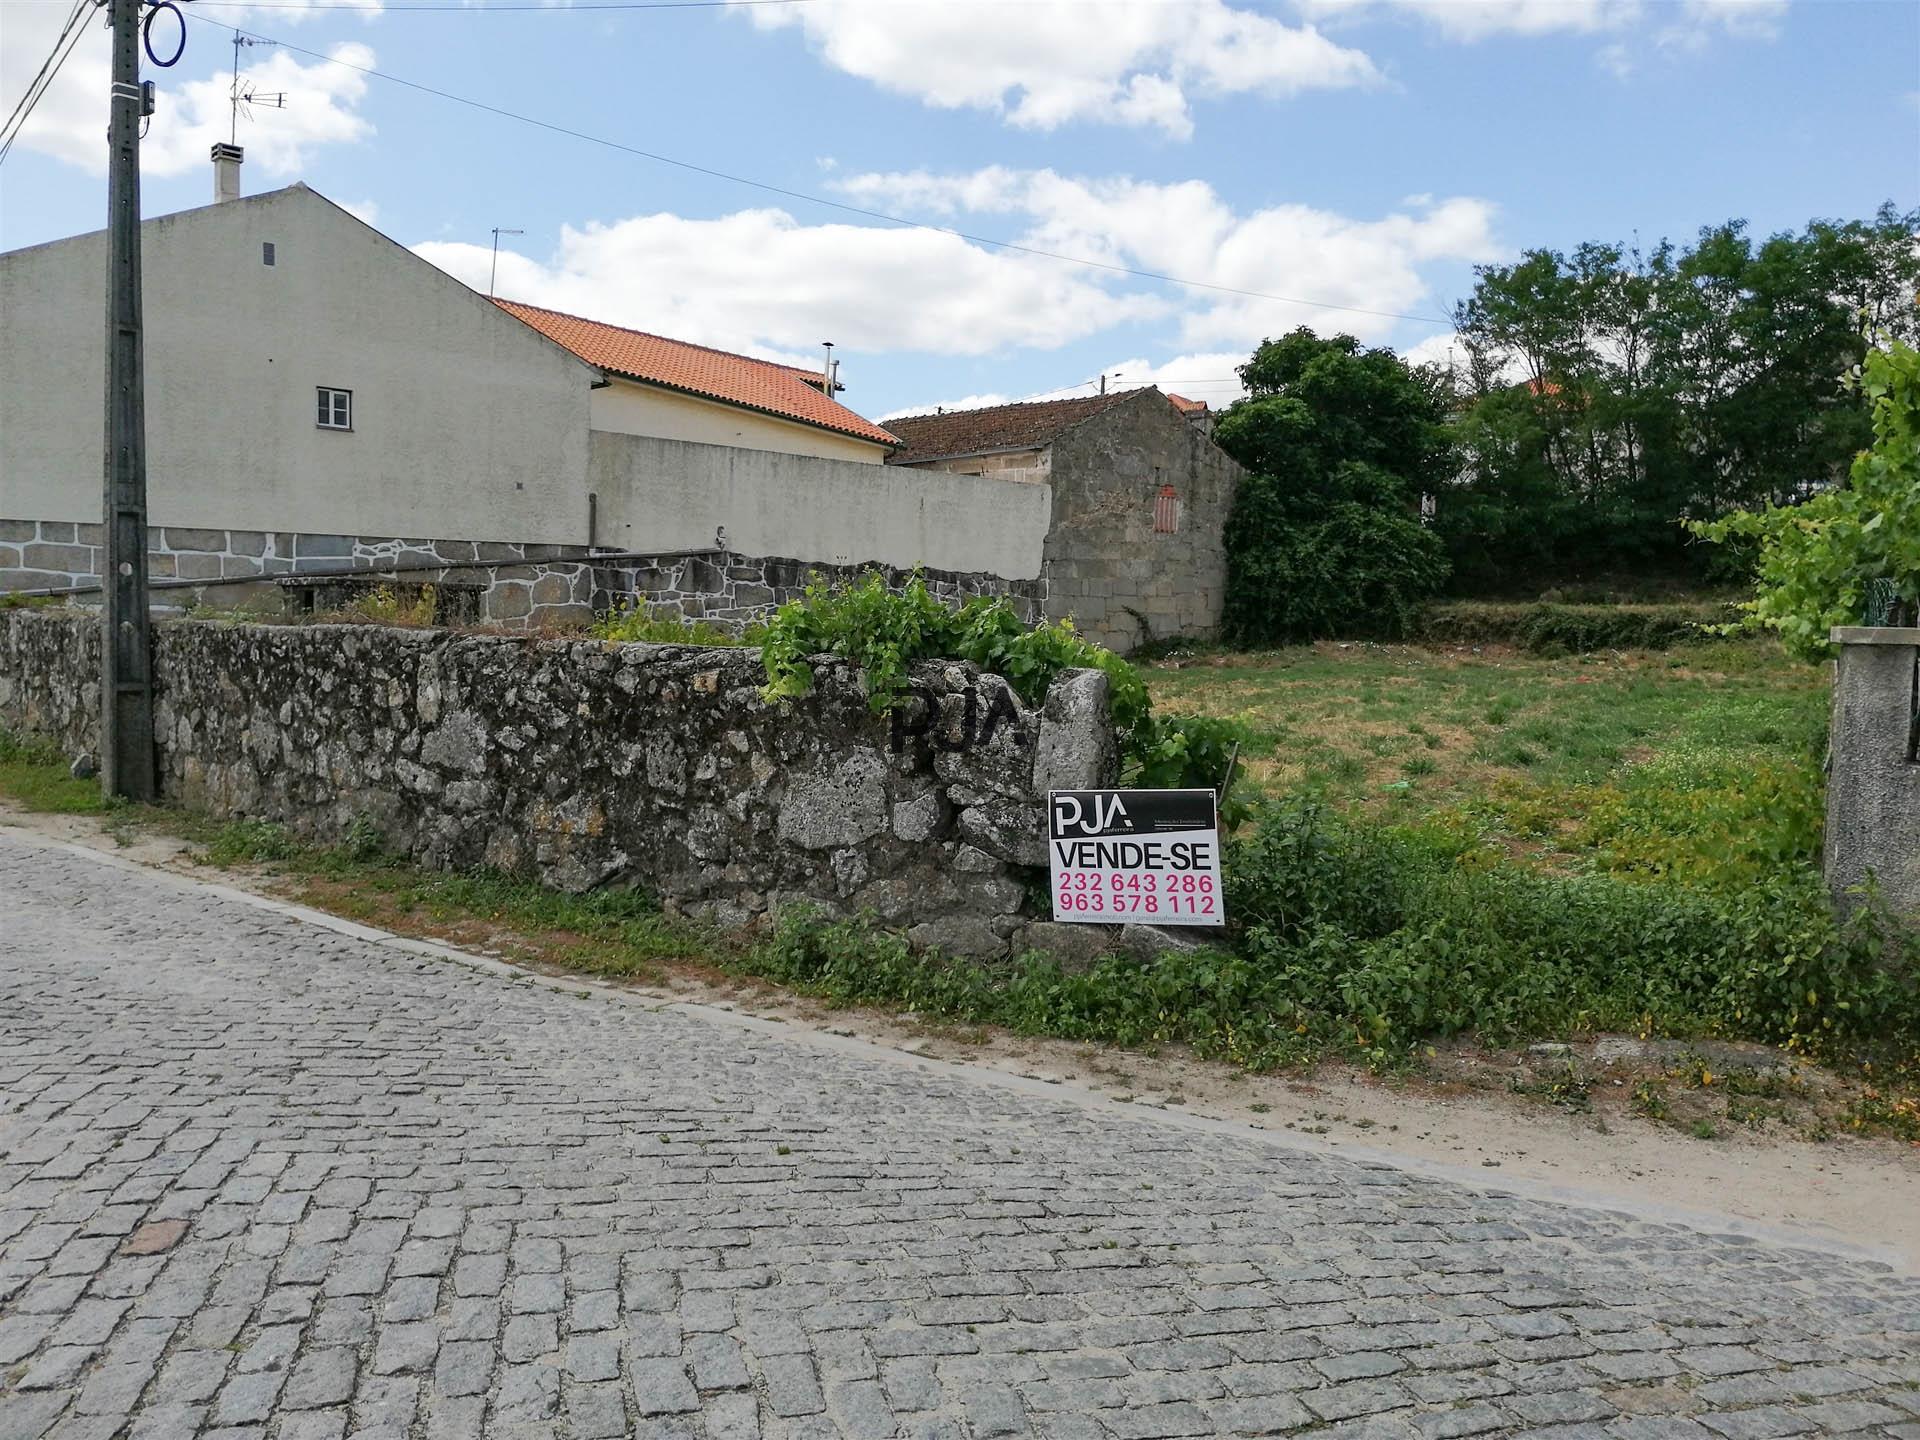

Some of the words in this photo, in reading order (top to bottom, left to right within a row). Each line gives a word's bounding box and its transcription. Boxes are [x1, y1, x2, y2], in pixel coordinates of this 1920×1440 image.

[1055, 794, 1133, 836] PJA
[1056, 842, 1212, 870] VENDE-SE
[1059, 873, 1102, 891] 232
[1111, 874, 1157, 892] 643
[1166, 875, 1213, 893] 286
[1060, 893, 1104, 911] 963
[1113, 895, 1158, 913] 578
[1169, 896, 1215, 914] 112
